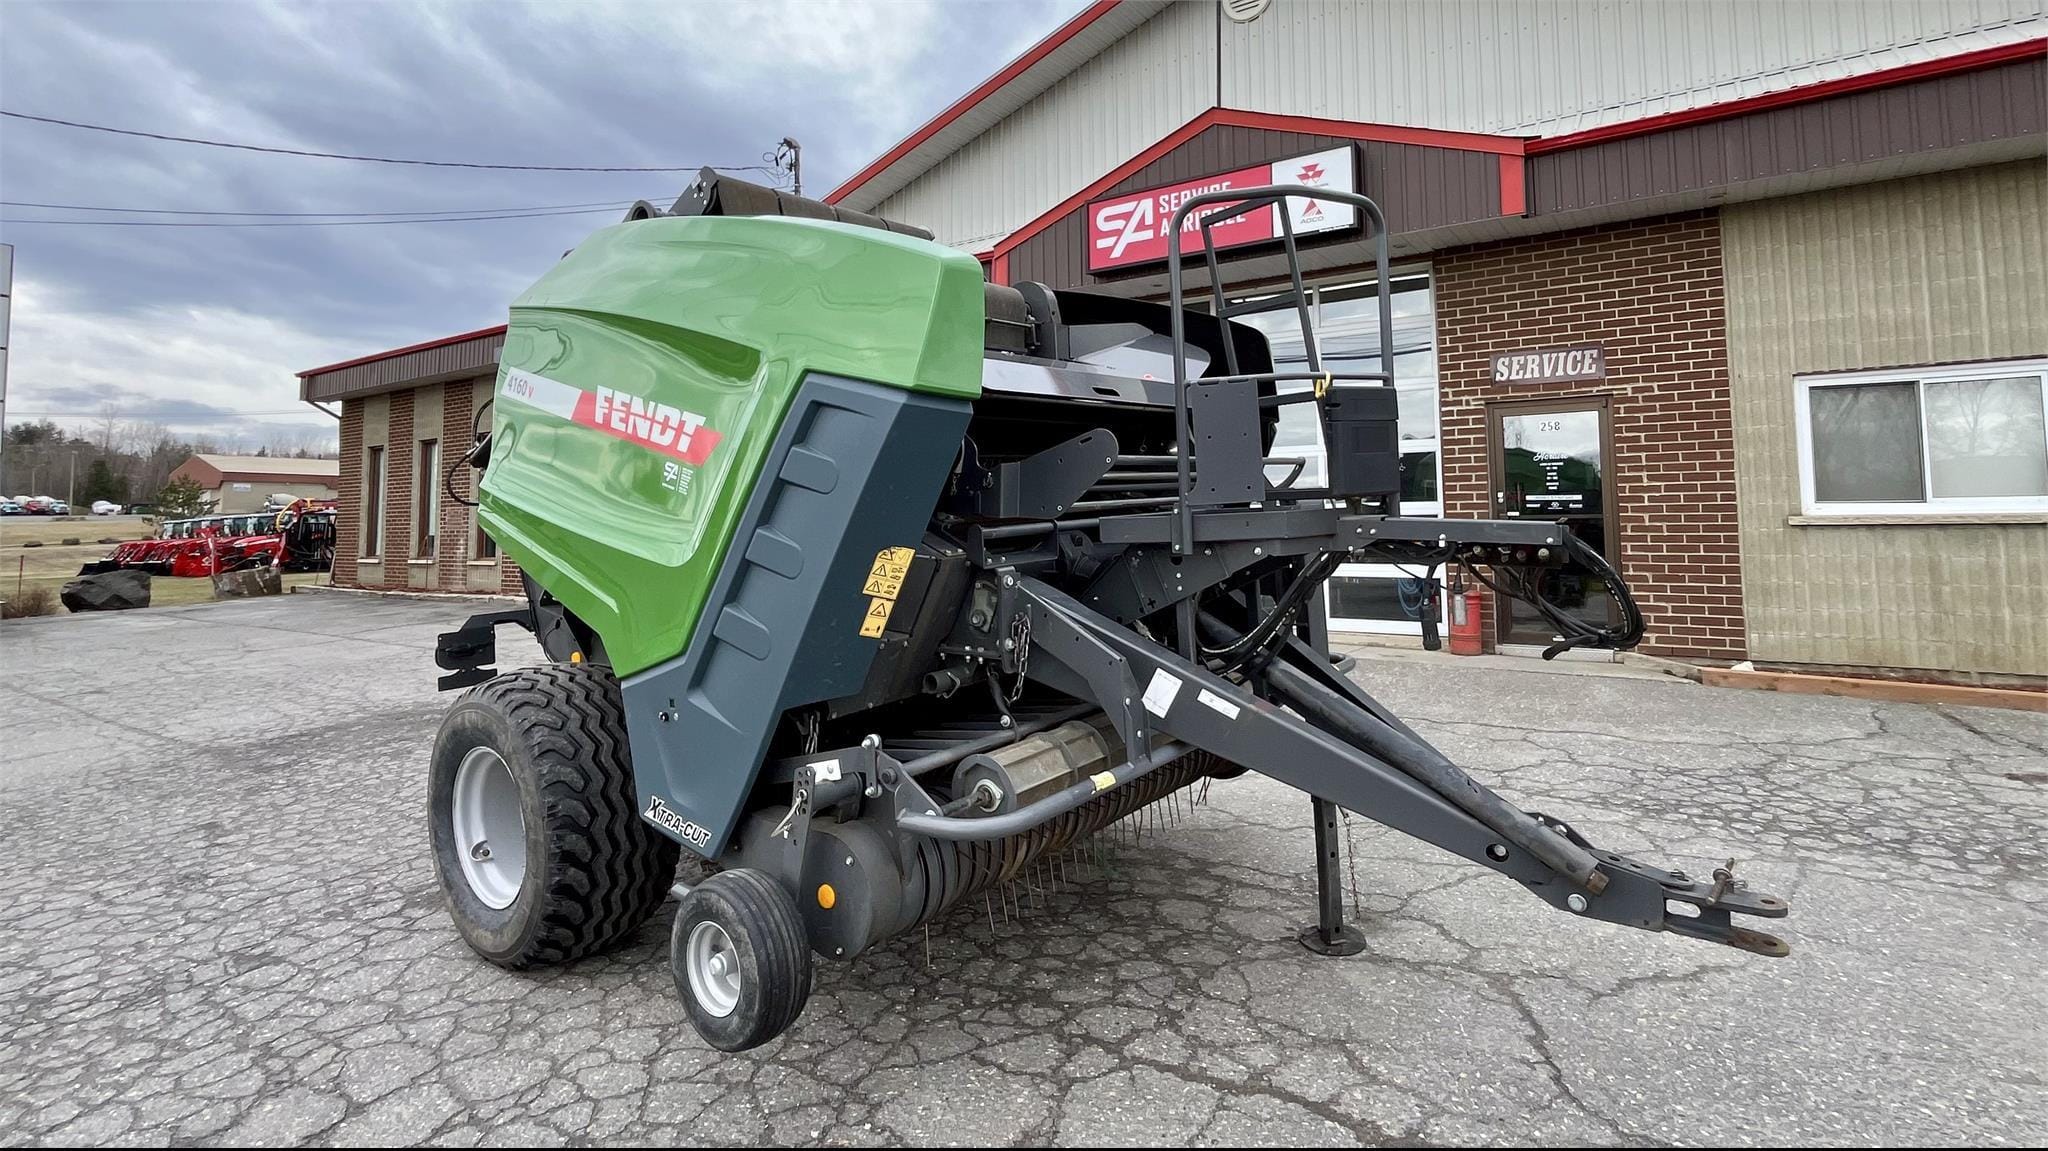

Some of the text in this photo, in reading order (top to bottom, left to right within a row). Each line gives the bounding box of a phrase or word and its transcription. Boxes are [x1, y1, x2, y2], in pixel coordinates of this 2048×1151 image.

[1495, 349, 1598, 381] SERVICE
[508, 375, 528, 396] 4160
[595, 385, 706, 453] FENDT
[1540, 421, 1561, 432] 258
[644, 795, 711, 848] XTRA-CUT
